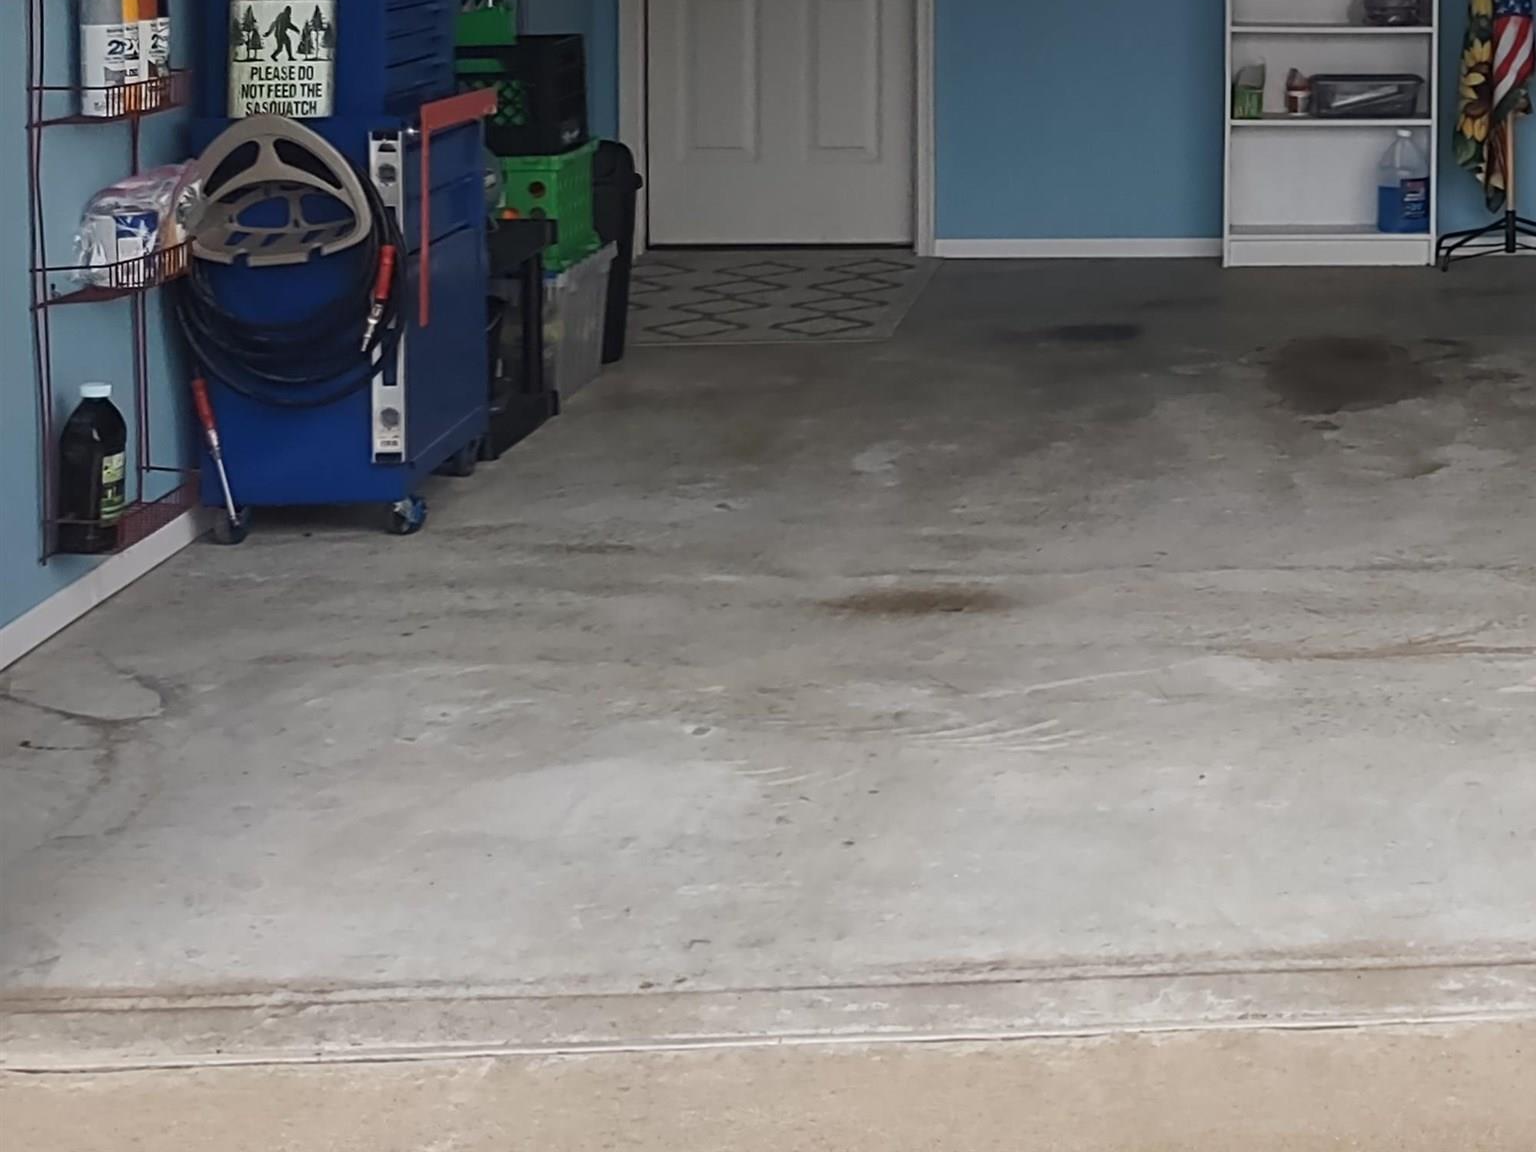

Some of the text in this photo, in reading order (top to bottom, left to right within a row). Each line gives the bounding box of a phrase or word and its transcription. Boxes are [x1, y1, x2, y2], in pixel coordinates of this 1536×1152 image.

[250, 65, 315, 81] PLEASE DO
[241, 83, 323, 98] NOT FEED THE
[245, 100, 318, 116] SASQUATCH
